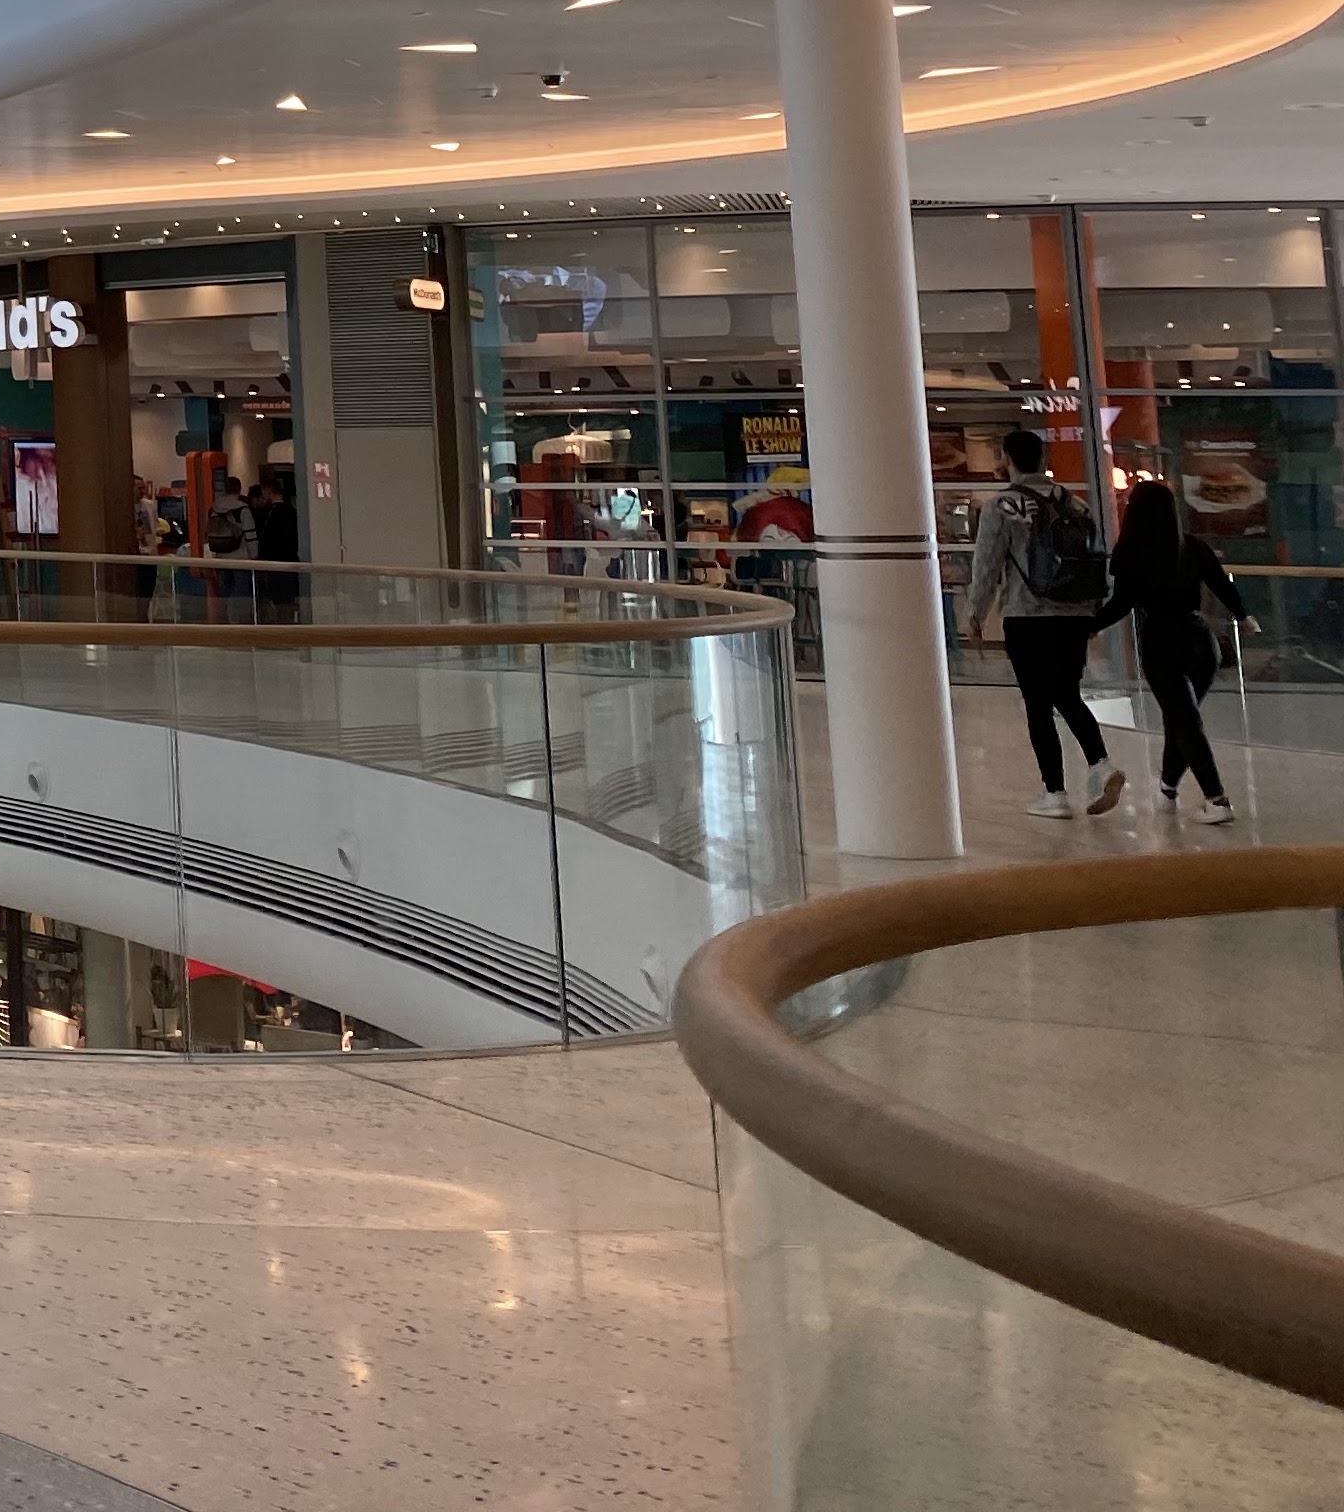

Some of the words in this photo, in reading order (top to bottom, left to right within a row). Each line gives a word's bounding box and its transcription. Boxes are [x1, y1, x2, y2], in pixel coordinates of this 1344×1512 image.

[742, 416, 801, 434] RONALD
[745, 437, 761, 454] LE
[762, 436, 802, 453] SHOW
